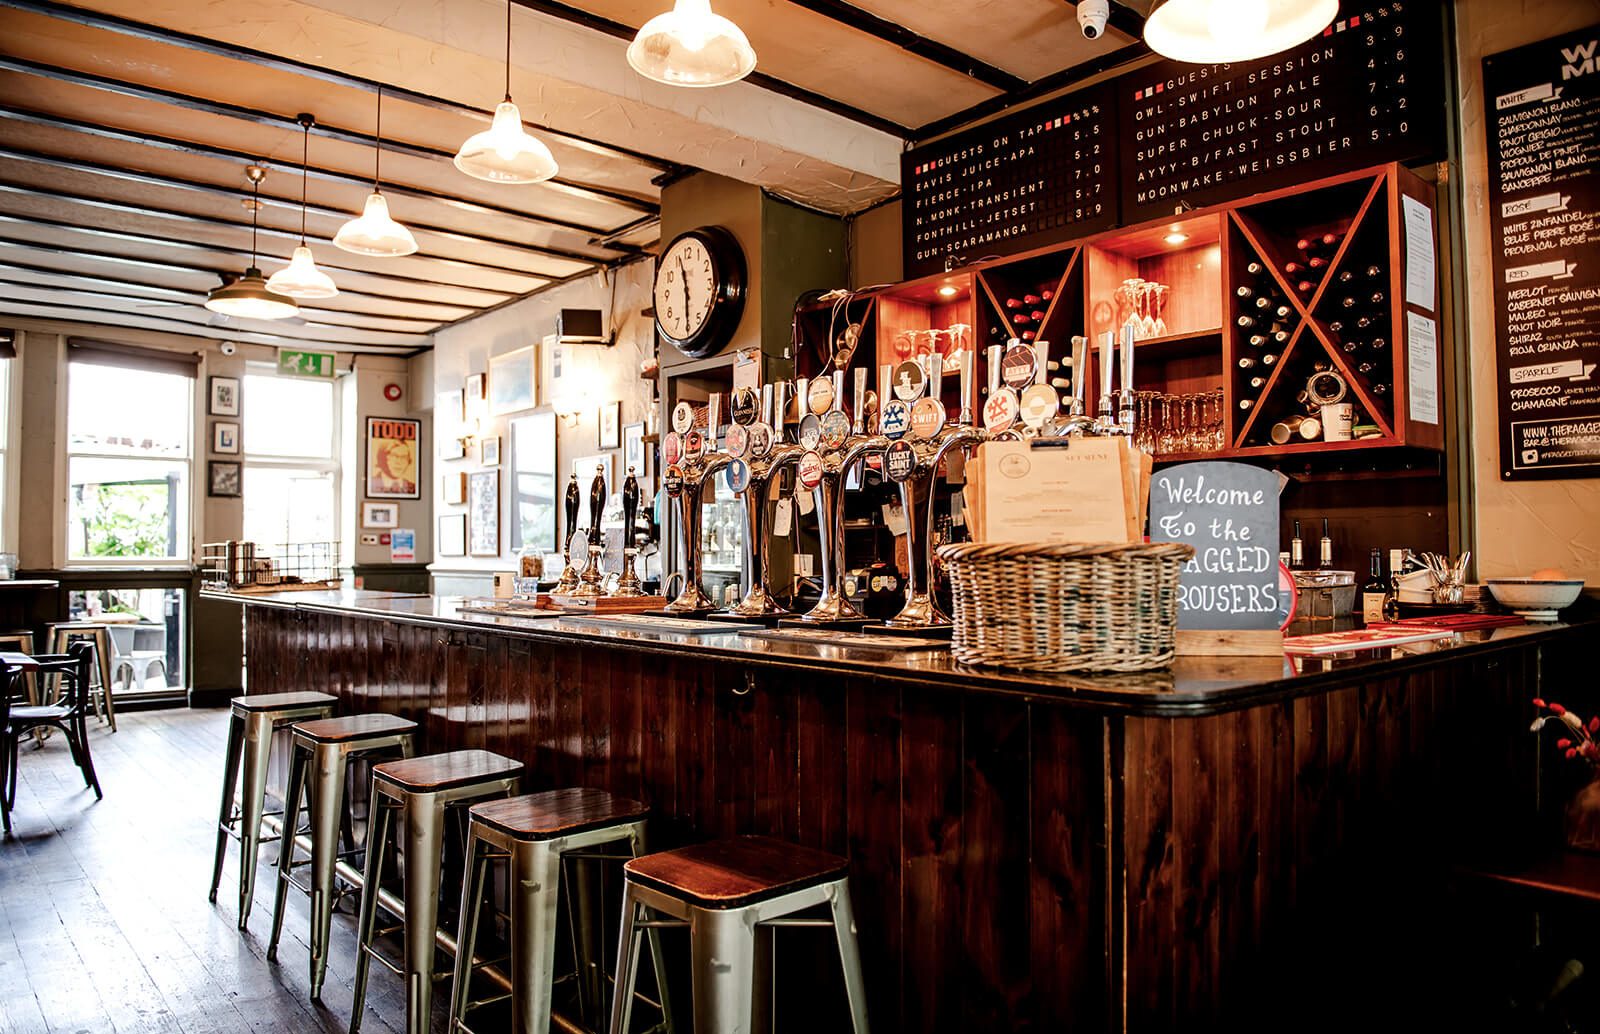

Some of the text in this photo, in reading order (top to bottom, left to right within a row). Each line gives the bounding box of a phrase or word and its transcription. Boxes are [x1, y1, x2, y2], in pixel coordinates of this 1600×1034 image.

[1136, 48, 1333, 120] OWL-SWIFT SESSION
[1167, 63, 1231, 89] GUESTS
[1136, 75, 1320, 140] GUN-BABYLON PALE
[1499, 106, 1548, 126] SAUVIGNON
[1550, 97, 1581, 113] BLANC
[1137, 99, 1321, 161] SUPER CHUCK-SOUR
[1500, 134, 1527, 149] PINOT
[938, 145, 983, 167] GUESTS
[994, 136, 1008, 148] ON
[1019, 124, 1042, 139] TAP
[1138, 117, 1335, 182] AYYY-B/FAST STOUT
[1500, 141, 1544, 159] VIOGNIER
[1539, 150, 1552, 161] DE
[916, 146, 1034, 192] EAVIS JUICE-APA
[1138, 137, 1350, 203] MOONWAKE-WEISSBIER
[1501, 161, 1552, 181] SAUVIGNON
[1555, 154, 1587, 169] BLANC
[916, 178, 992, 208] FIERCE-IPA
[917, 202, 1035, 243] FONTHILL-JETSET
[1504, 222, 1529, 235] WHITE
[1530, 211, 1586, 229] ZINFANDEL
[917, 223, 1027, 259] GUN-SCARAMANGA
[1508, 285, 1548, 301] MERLOT
[1508, 295, 1558, 312] CABERNET
[1508, 309, 1546, 323] MALBEC
[1508, 321, 1534, 334] PINOT
[1537, 317, 1562, 330] NOIR
[1509, 332, 1542, 345] SHIRAZ
[1509, 344, 1535, 357] RIOJA
[1537, 339, 1579, 353] CRIANZA
[1514, 365, 1562, 380] SPARKLE
[1510, 386, 1561, 400] PROSECCO
[913, 413, 937, 424] SWIFT
[889, 451, 910, 460] LUCKY
[889, 460, 910, 470] SAINT
[1159, 475, 1264, 505] Welcome
[1159, 512, 1251, 541] To the
[1183, 546, 1270, 574] AGGED
[1176, 583, 1278, 615] ROUSERS
